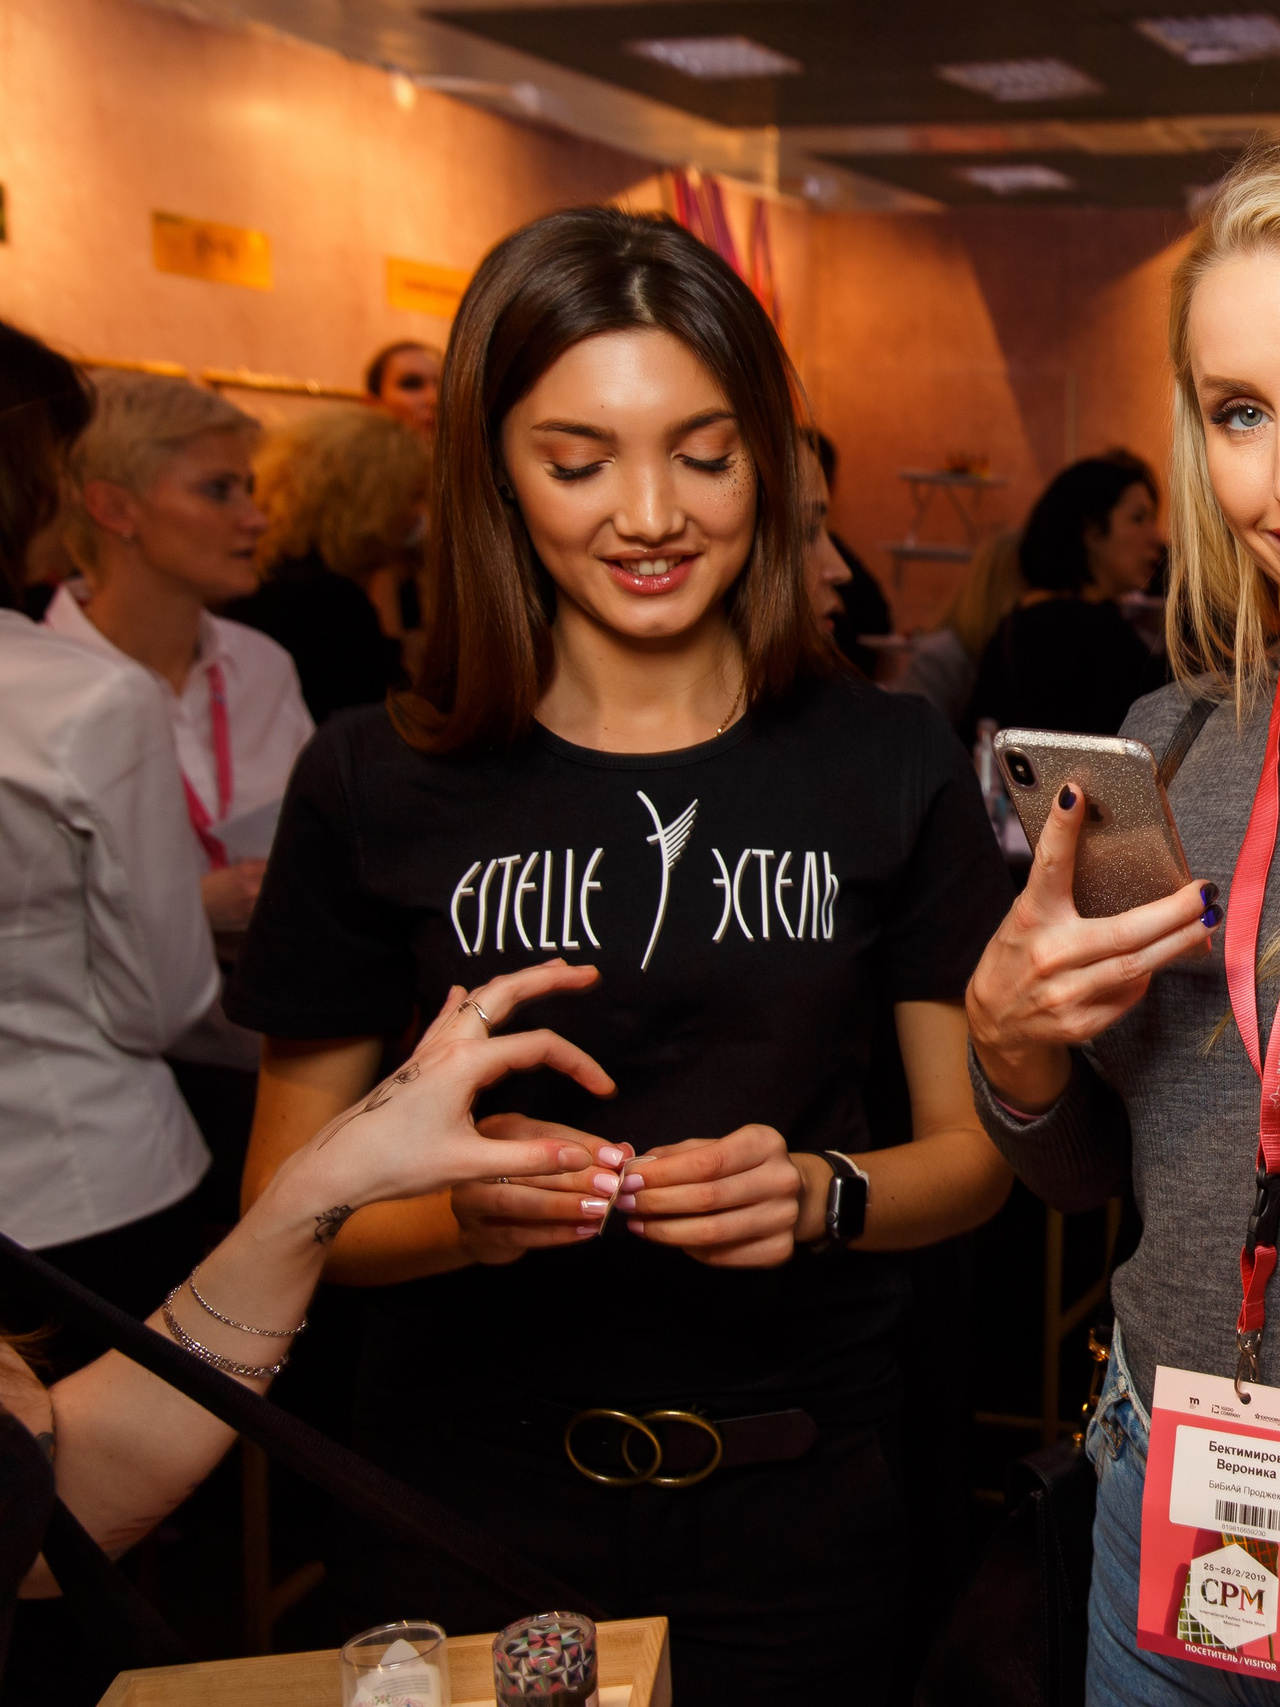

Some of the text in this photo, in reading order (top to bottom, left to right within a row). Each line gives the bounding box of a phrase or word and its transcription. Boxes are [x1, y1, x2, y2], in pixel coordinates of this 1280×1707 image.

[450, 848, 603, 956] ESTELLE
[711, 848, 839, 943] ЭСТЕЛЬ
[1216, 1458, 1277, 1480] Вероника
[1208, 1480, 1242, 1495] БиБиАй
[1203, 1562, 1267, 1583] 25-28/2/2019
[1200, 1578, 1266, 1615] CPM
[1184, 1643, 1239, 1663] ПОСЕТИТЕЛЬ
[1244, 1657, 1278, 1672] VISITOR
